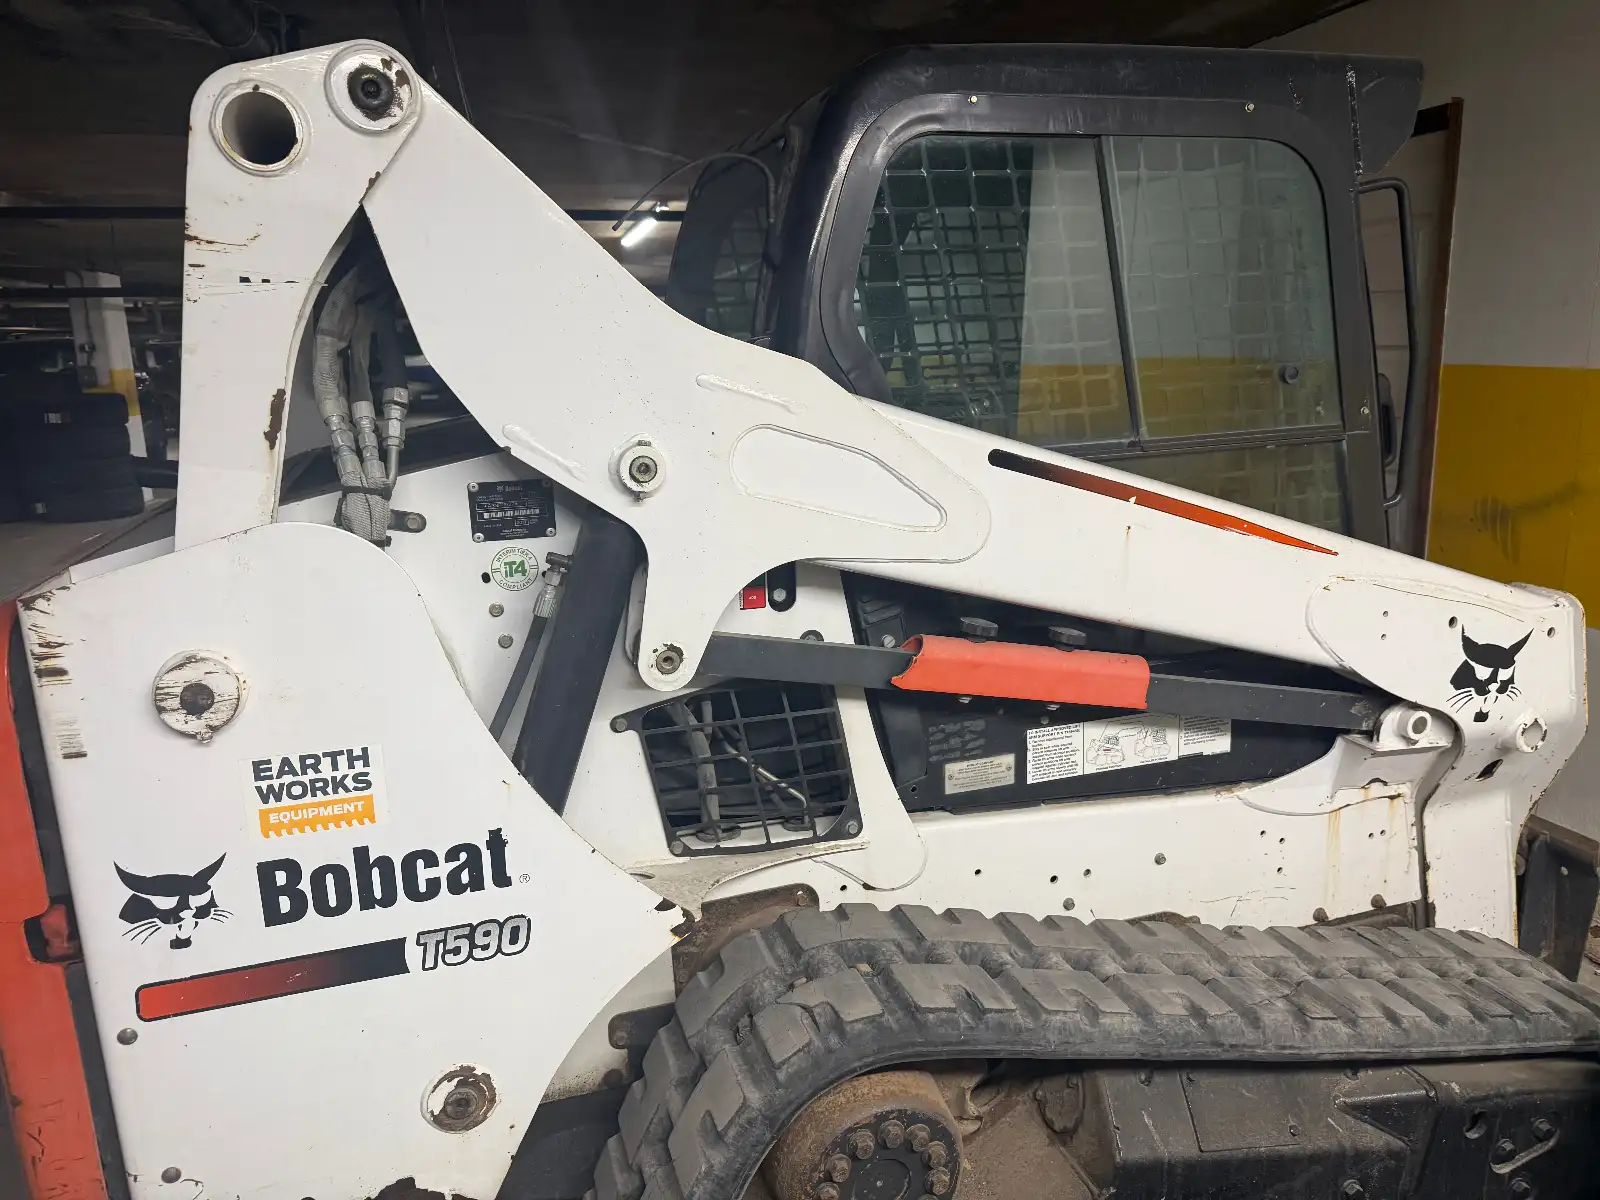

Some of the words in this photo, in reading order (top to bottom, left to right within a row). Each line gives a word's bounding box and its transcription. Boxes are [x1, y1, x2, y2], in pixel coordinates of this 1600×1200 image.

[496, 549, 516, 562] INTERIM
[503, 560, 527, 578] iT4
[499, 578, 533, 590] COMPLIANT
[252, 746, 370, 782] EARTH
[255, 772, 373, 804] WORKS
[269, 801, 364, 823] EQUIPMENT
[256, 828, 512, 927] Bobcat
[416, 914, 531, 971] T590
